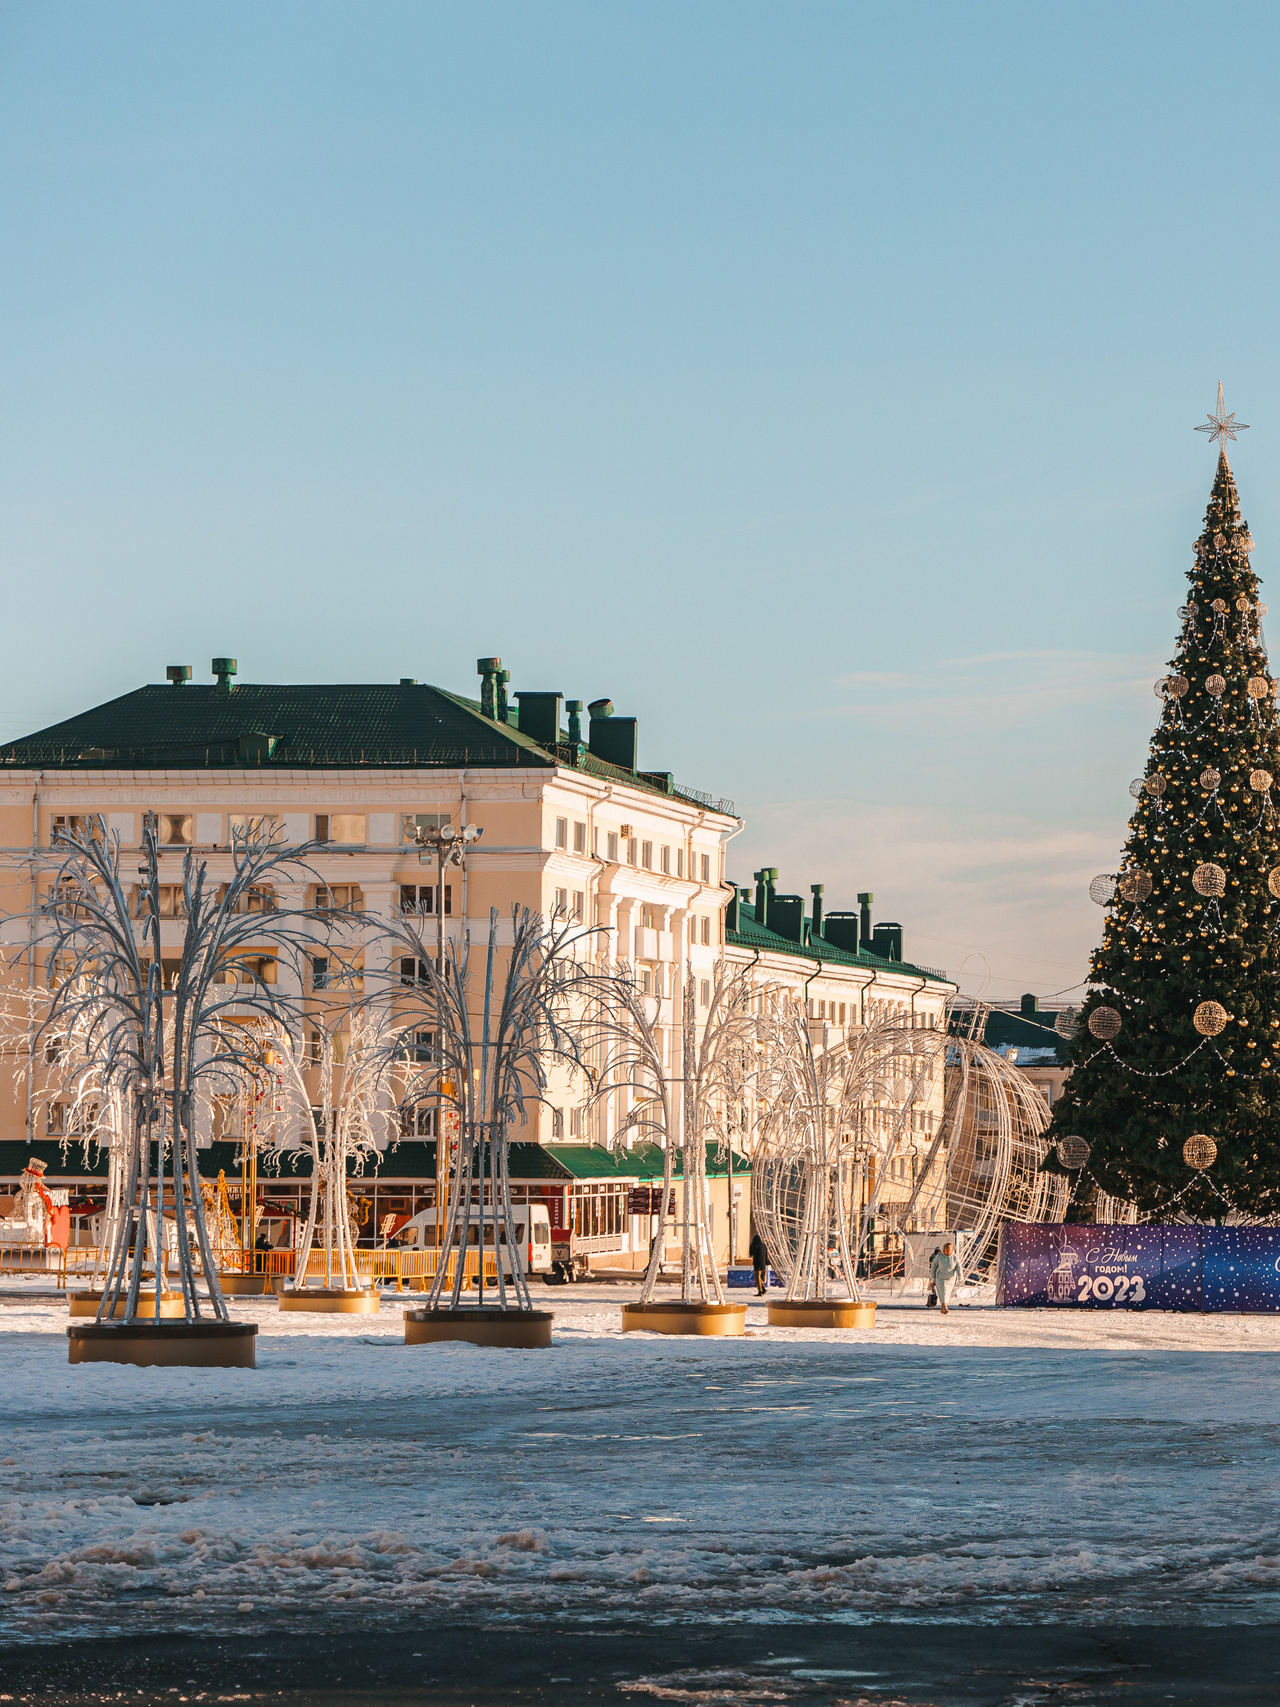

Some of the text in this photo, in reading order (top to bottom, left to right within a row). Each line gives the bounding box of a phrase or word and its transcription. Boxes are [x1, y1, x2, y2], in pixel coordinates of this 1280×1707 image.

[1085, 1246, 1138, 1264] С Новым
[1094, 1264, 1128, 1274] годом!
[1077, 1275, 1146, 1302] 2023
